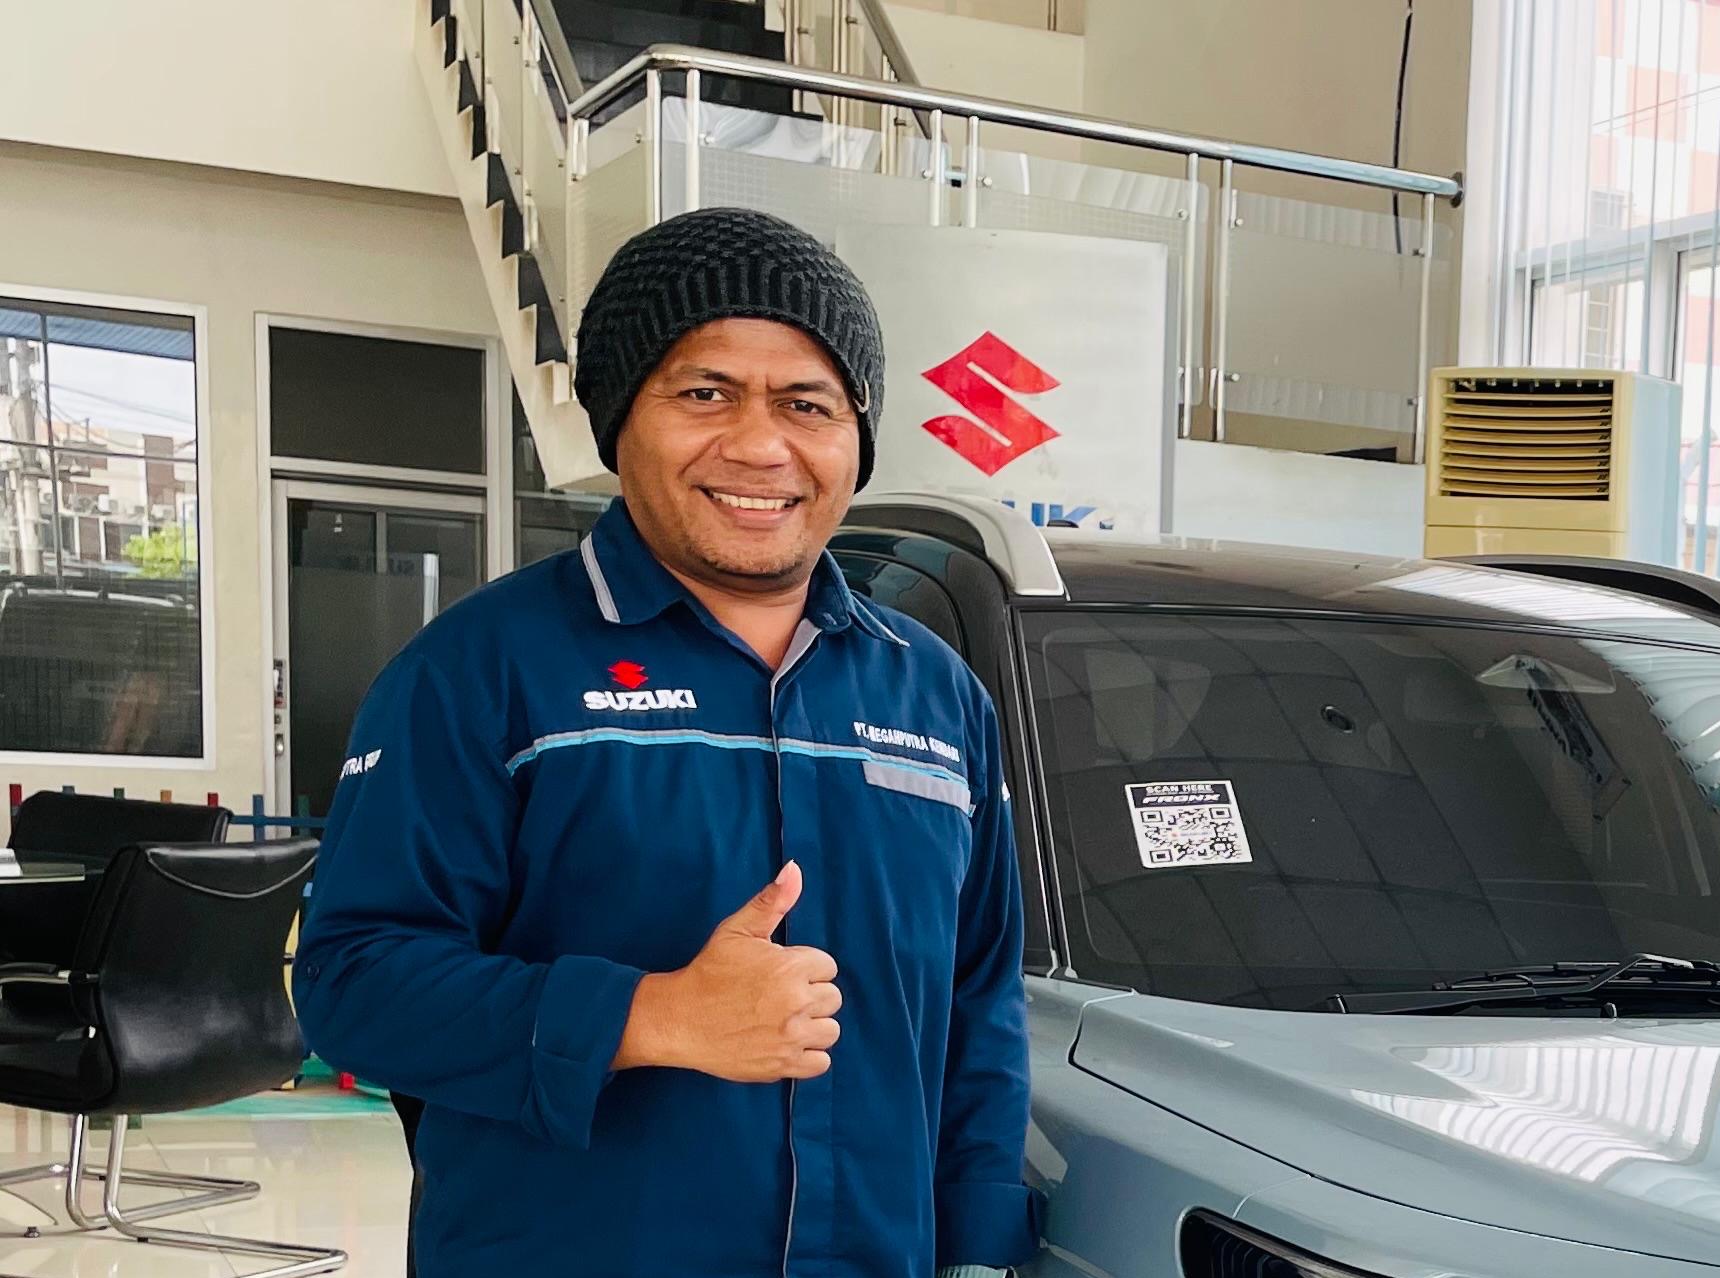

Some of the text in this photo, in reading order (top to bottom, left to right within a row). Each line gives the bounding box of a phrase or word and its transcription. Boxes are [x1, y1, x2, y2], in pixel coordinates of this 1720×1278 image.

[583, 690, 698, 711] SUZUKI
[1145, 784, 1213, 794] SCAN HERE
[1142, 793, 1221, 804] FRONX
